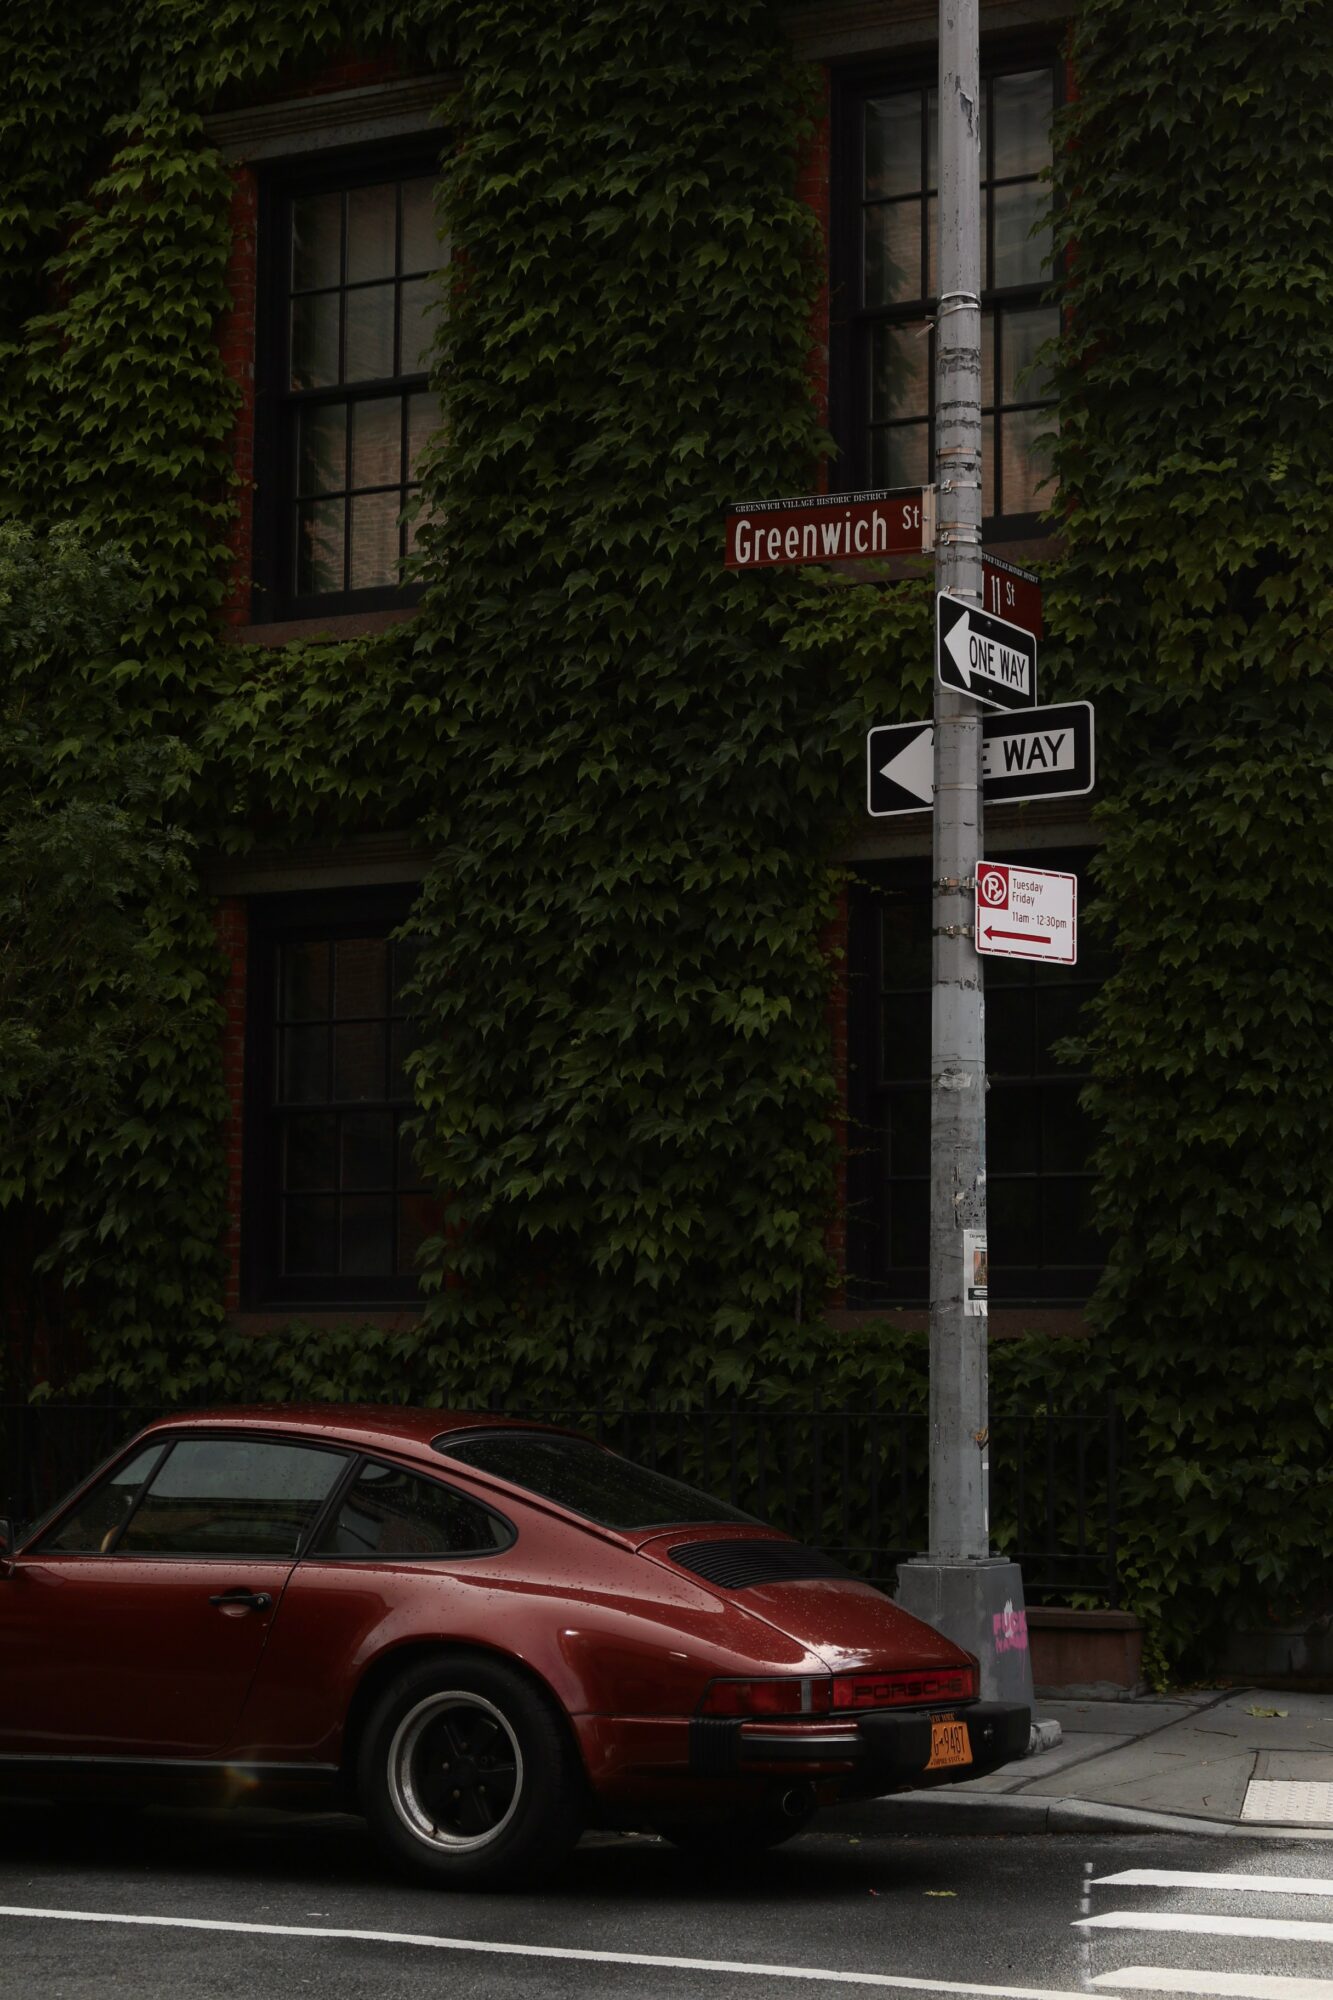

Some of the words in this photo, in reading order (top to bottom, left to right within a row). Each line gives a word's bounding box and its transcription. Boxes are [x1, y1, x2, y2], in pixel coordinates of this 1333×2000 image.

[735, 502, 780, 513] GREENWICH
[782, 499, 815, 509] VILLAGE
[817, 495, 852, 506] HISTORIC
[854, 492, 888, 503] DISTRICT
[735, 509, 887, 564] Greenwich
[902, 504, 920, 530] St
[990, 575, 1001, 615] 11
[1006, 580, 1016, 608] St
[969, 635, 996, 677] ONE
[999, 647, 1026, 688] WAY
[1003, 733, 1066, 772] WAY
[1012, 878, 1044, 895] Tuesday
[1012, 891, 1035, 907] Friday
[1012, 911, 1030, 924] 11am
[1036, 914, 1067, 930] 12:30pm
[853, 1678, 963, 1701] PORSCHE
